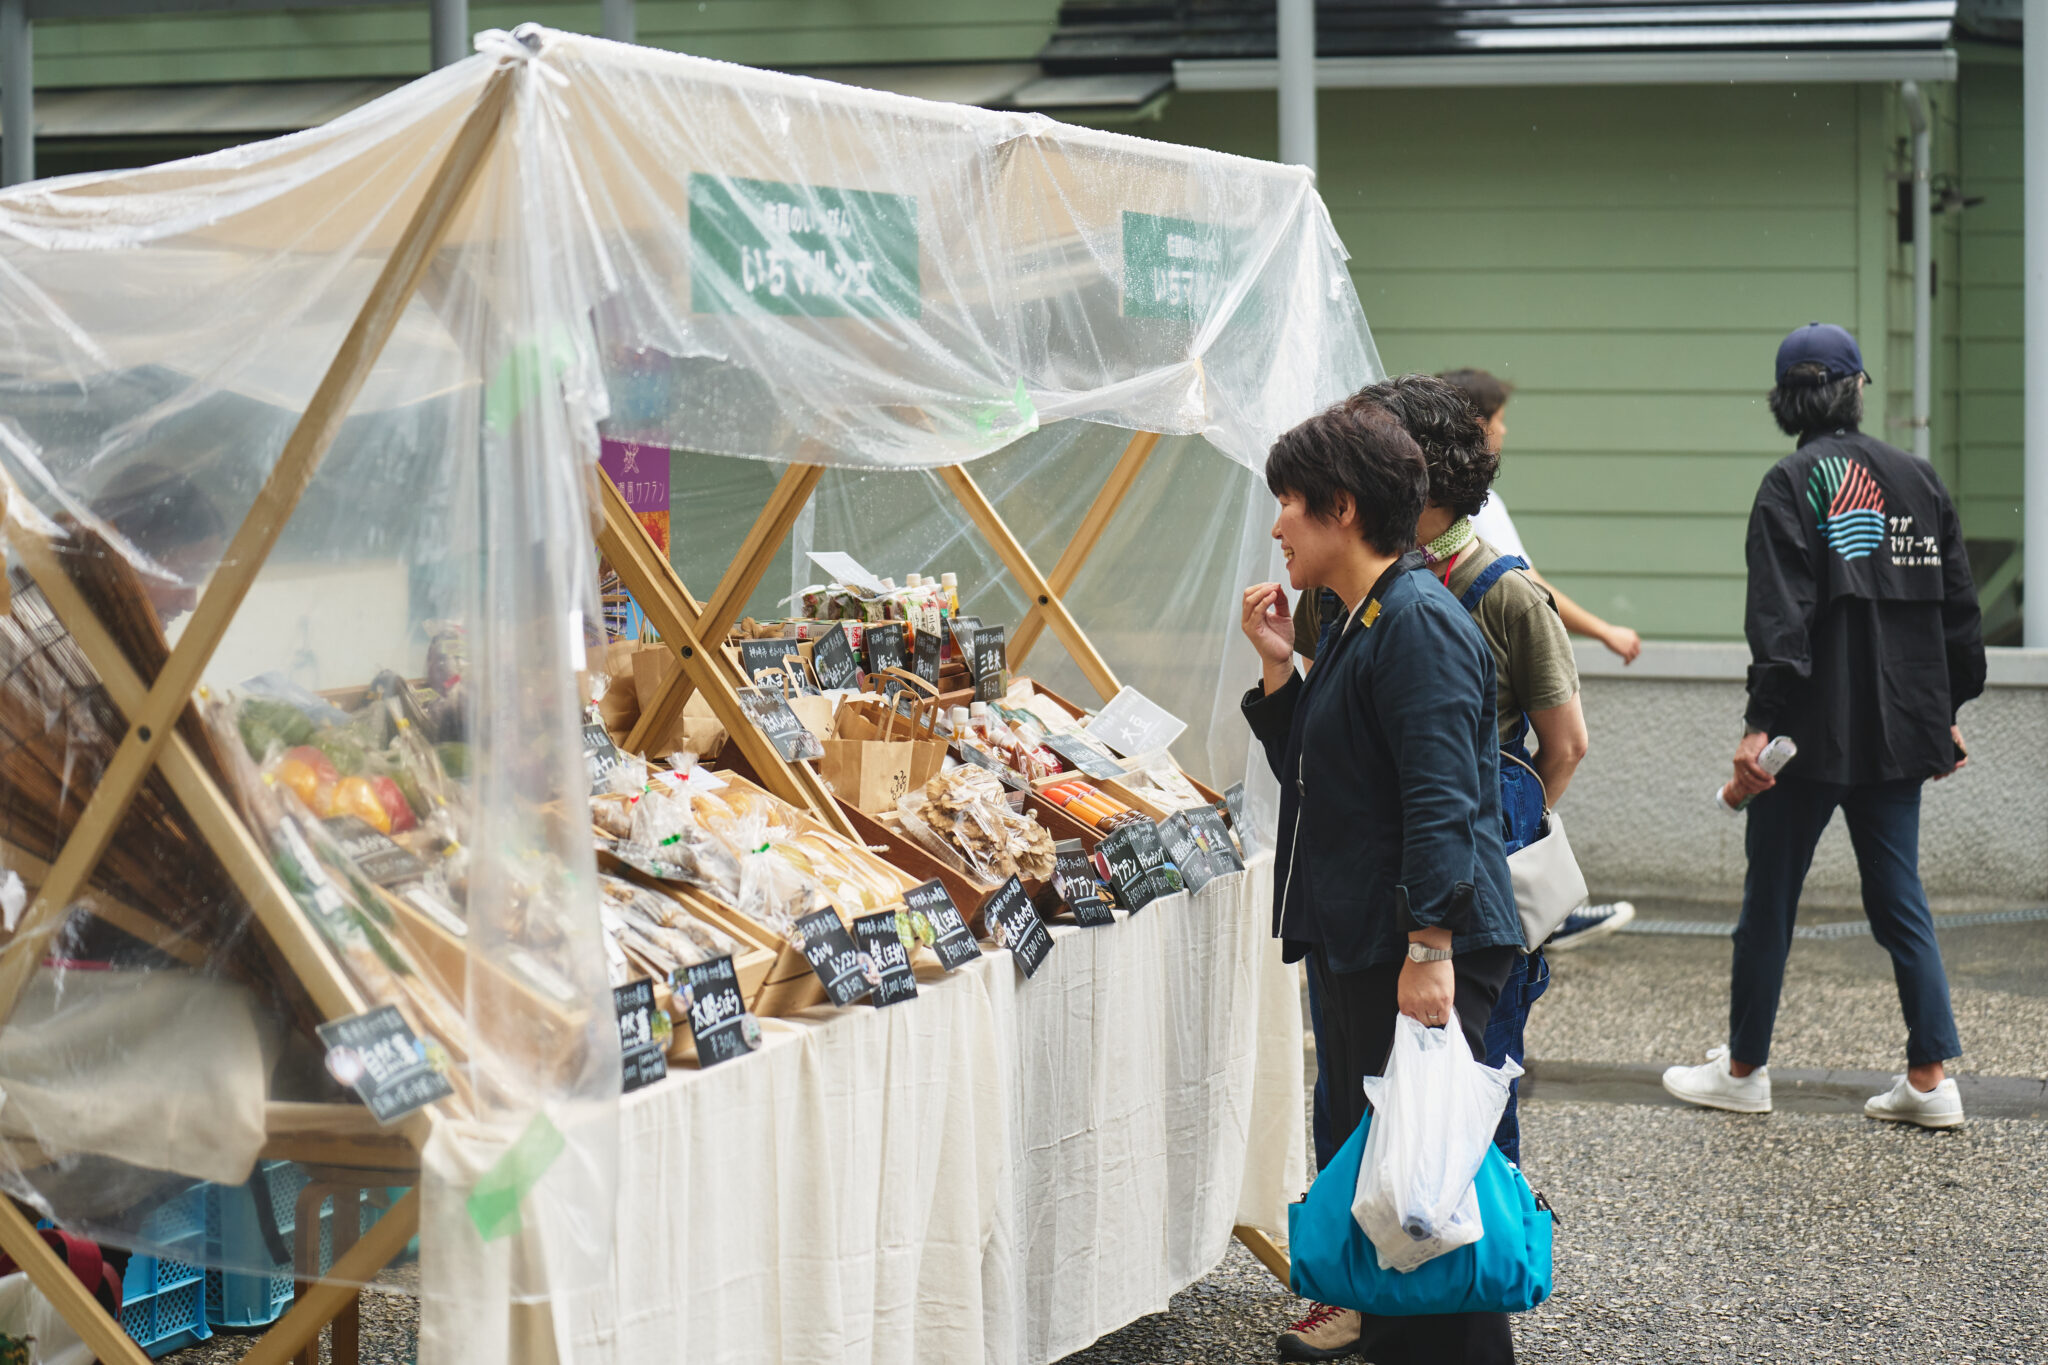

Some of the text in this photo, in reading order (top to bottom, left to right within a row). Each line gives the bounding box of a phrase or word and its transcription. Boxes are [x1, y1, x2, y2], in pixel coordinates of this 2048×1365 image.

[1889, 516, 1913, 533] サガ
[1889, 536, 1939, 554] マリアージュ
[980, 650, 1002, 674] 三色米
[1109, 859, 1140, 885] サフラン
[1066, 876, 1099, 897] サフラン
[830, 951, 862, 975] レンコン
